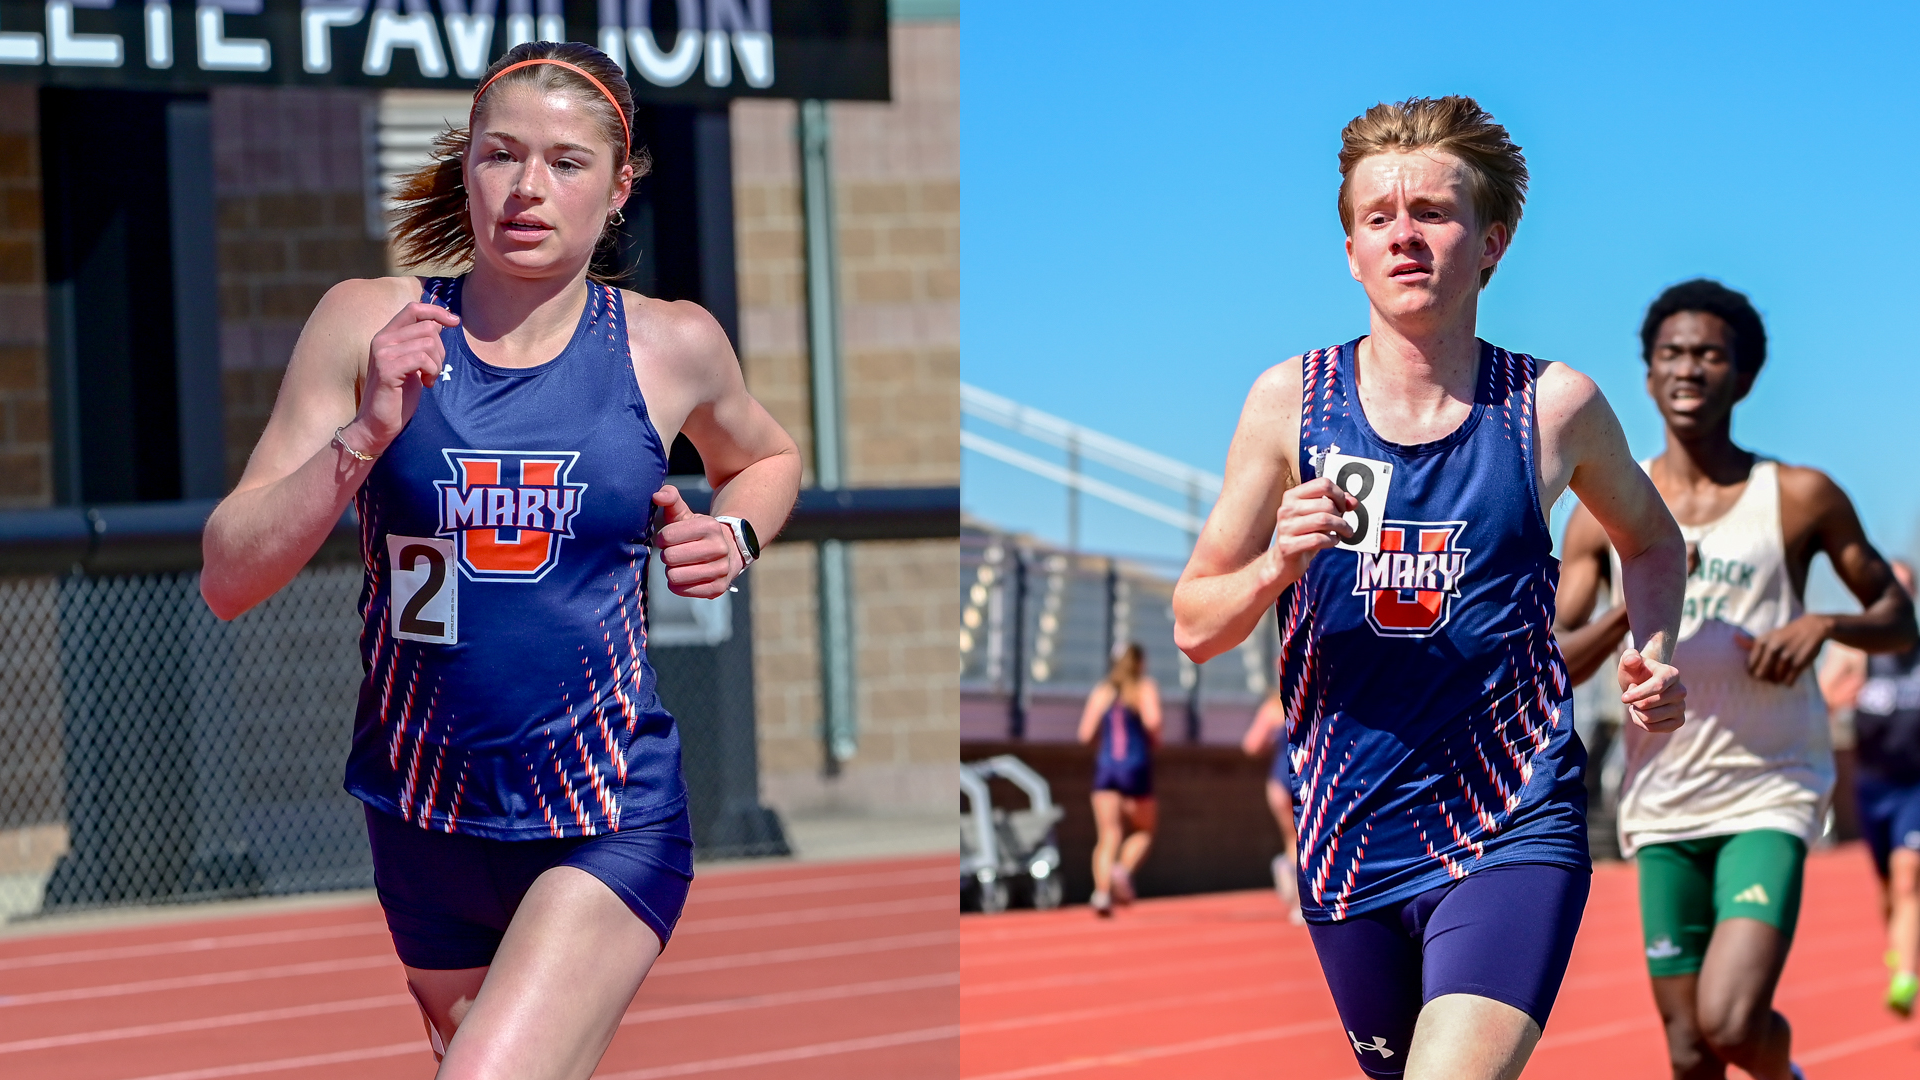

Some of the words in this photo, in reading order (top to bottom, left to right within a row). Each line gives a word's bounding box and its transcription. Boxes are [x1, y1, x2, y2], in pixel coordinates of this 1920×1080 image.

[0, 0, 272, 71] ETE
[444, 486, 578, 532] MARY
[1336, 461, 1375, 546] 8
[399, 543, 446, 638] 2
[1360, 552, 1463, 591] MARY
